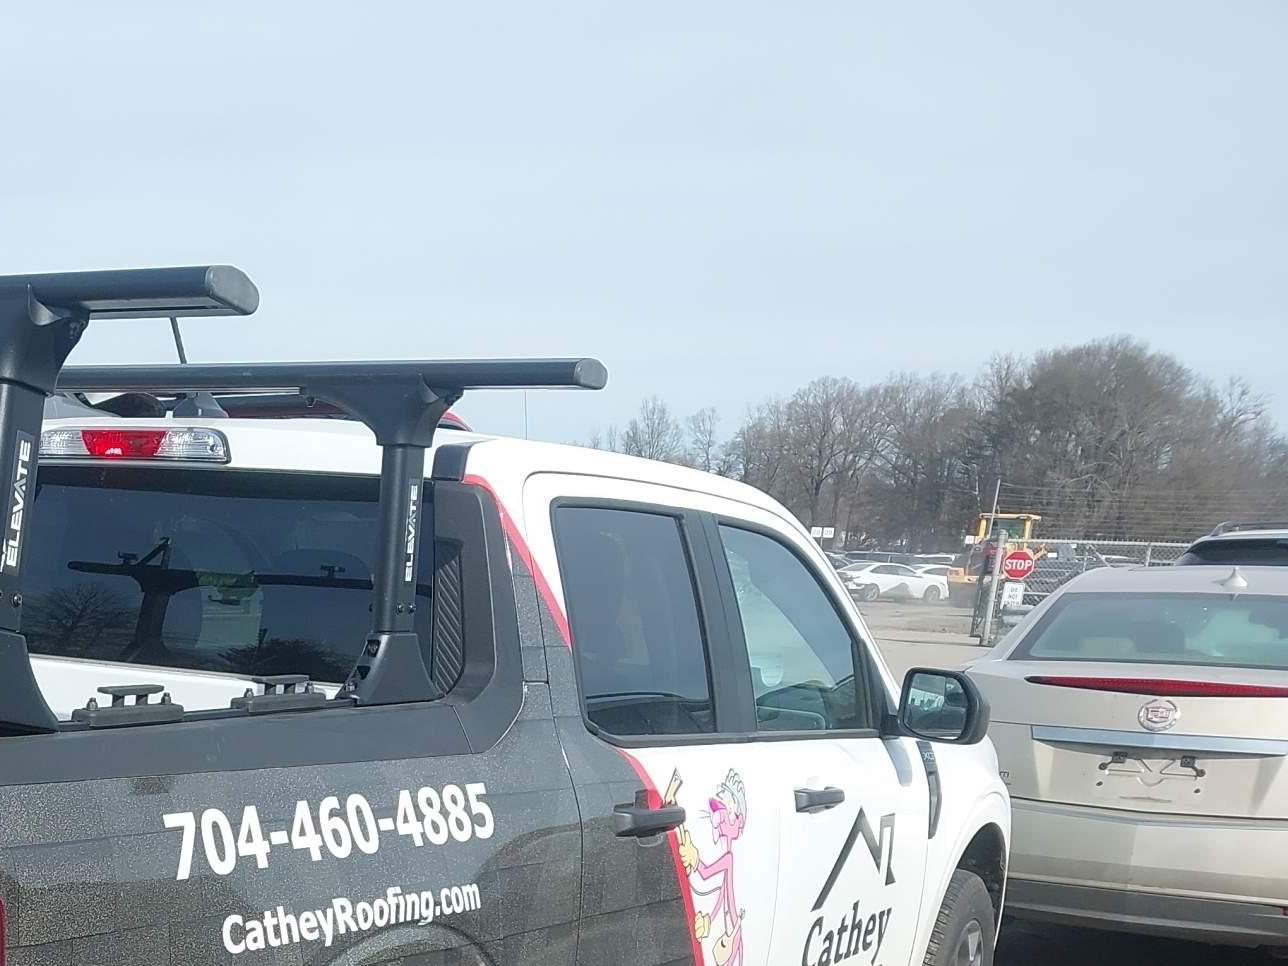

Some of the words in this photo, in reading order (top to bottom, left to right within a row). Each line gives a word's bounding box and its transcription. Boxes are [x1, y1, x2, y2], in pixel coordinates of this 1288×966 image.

[6, 440, 31, 567] ELEVATE
[405, 485, 418, 581] ELEVATE
[1004, 560, 1032, 571] STOP
[163, 783, 494, 880] 704-460-4885
[223, 884, 480, 953] CatheyRoofing.com
